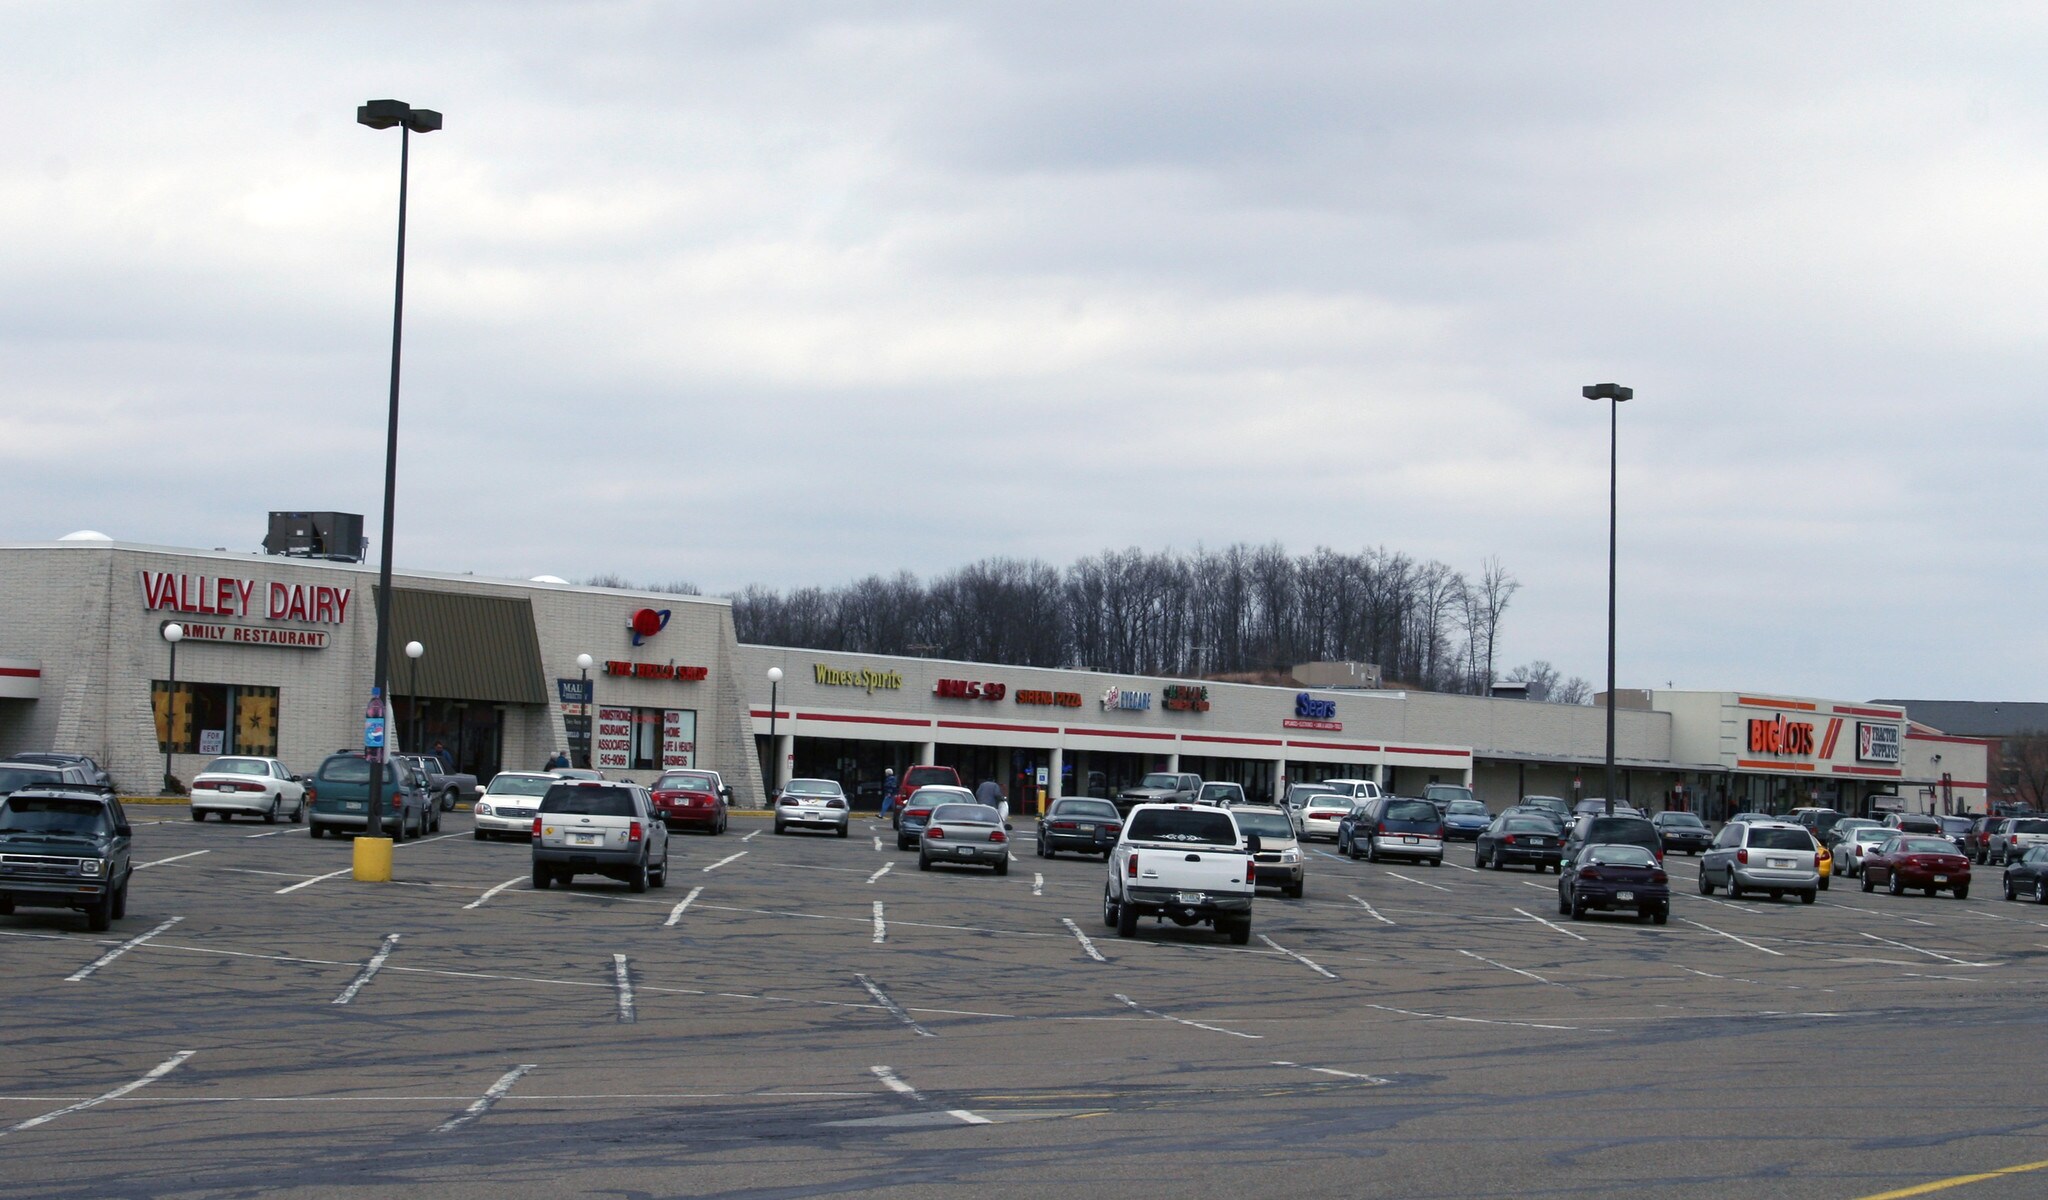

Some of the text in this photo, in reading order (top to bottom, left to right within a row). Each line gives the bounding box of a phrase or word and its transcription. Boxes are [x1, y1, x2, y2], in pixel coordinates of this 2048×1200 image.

[140, 570, 351, 624] VALLEY DAIRY
[234, 628, 325, 647] RESTAURANT
[816, 663, 854, 686] Wines
[863, 667, 903, 695] Spirits
[1056, 692, 1082, 708] PIZZA
[1120, 690, 1152, 710] EYECARE
[1298, 692, 1337, 719] Sears
[600, 709, 632, 722] ARMSTRONG
[600, 724, 629, 736] INSURANCE
[1750, 719, 1780, 753] BIG
[1784, 721, 1814, 755] LOTS
[1872, 727, 1898, 743] TRACTOR
[202, 744, 219, 753] RENT
[598, 739, 631, 752] ASSOCIATES
[1871, 743, 1892, 759] SUPPLY
